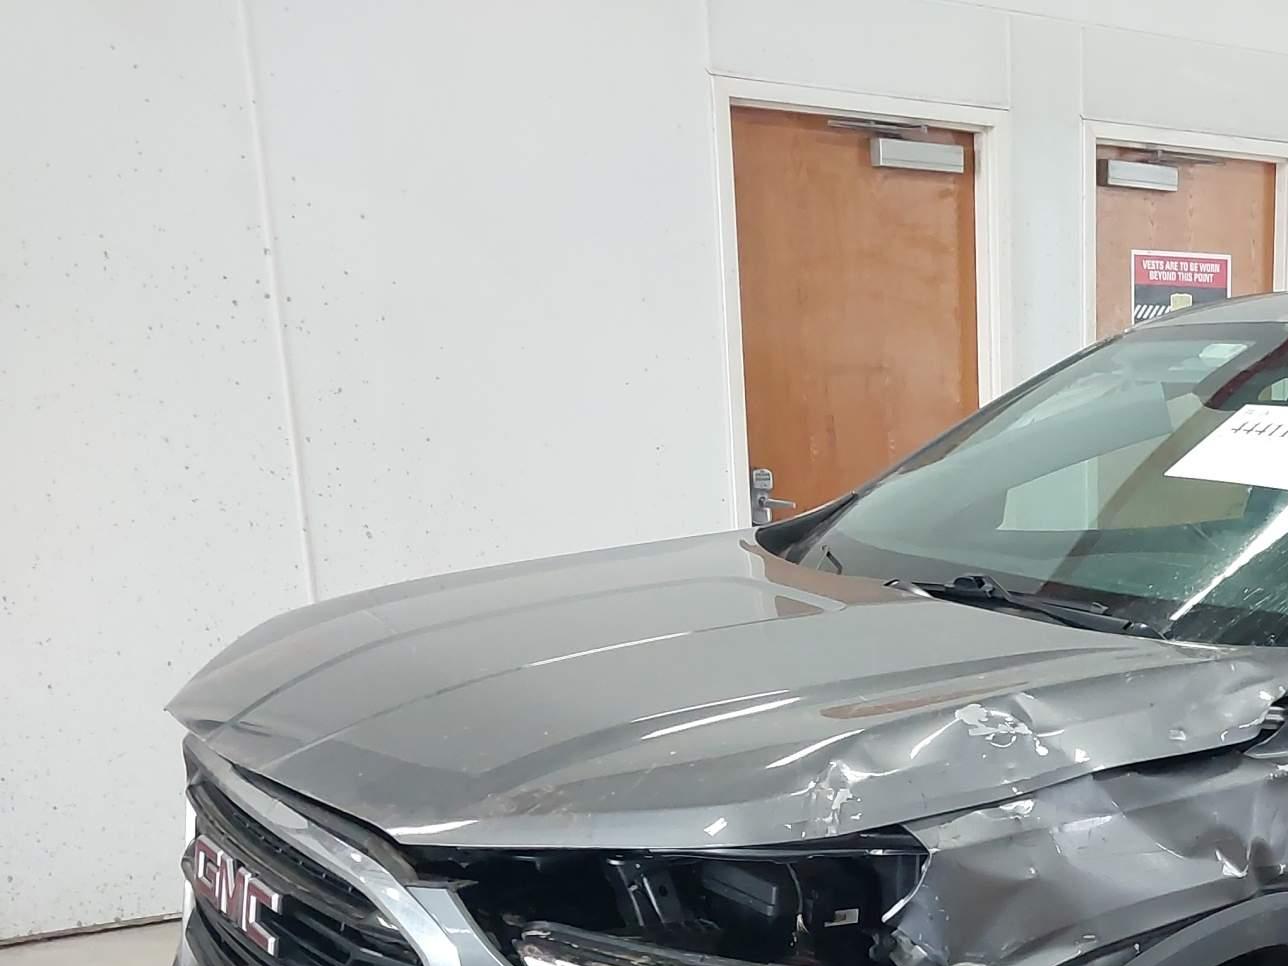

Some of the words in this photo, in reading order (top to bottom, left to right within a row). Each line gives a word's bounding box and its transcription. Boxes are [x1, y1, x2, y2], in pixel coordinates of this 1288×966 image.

[1142, 260, 1165, 270] VESTS
[1165, 261, 1178, 271] ARE
[1179, 262, 1189, 271] TO
[1190, 262, 1200, 272] BE
[1199, 263, 1220, 273] WORN
[1149, 271, 1177, 281] BEYOND
[1177, 272, 1193, 282] THIS
[1194, 273, 1215, 283] POINT
[194, 835, 283, 957] GMC
